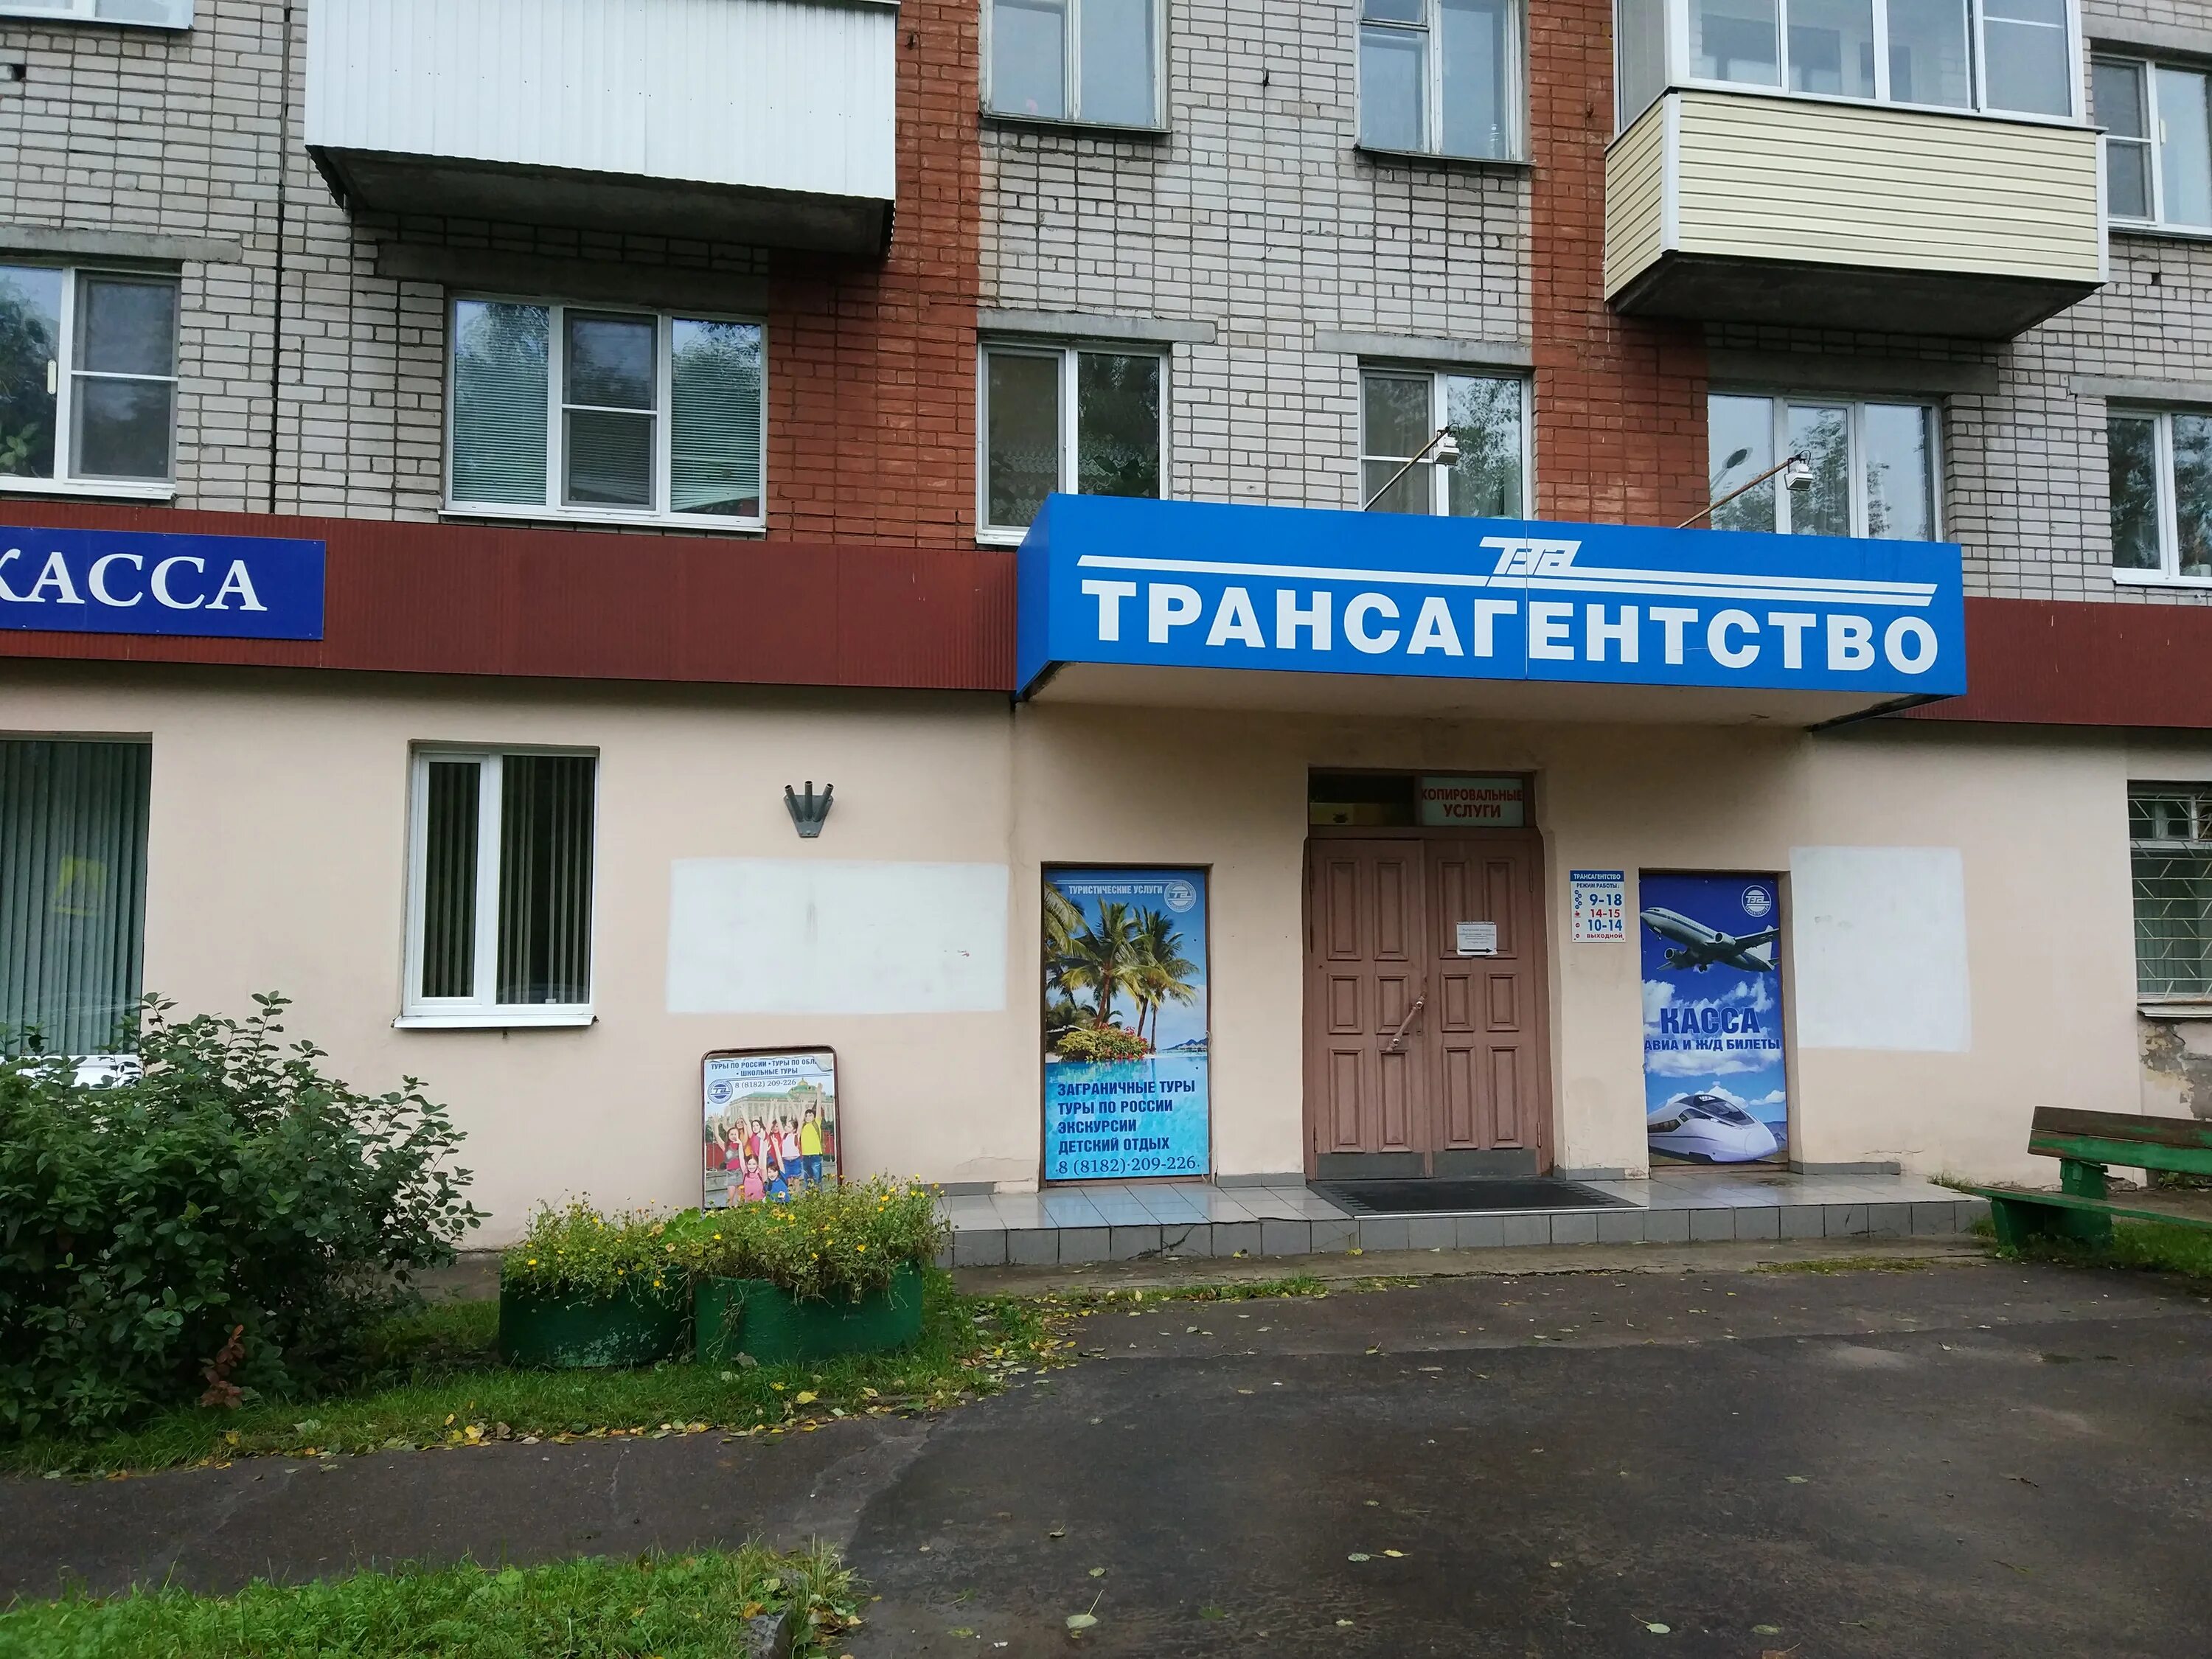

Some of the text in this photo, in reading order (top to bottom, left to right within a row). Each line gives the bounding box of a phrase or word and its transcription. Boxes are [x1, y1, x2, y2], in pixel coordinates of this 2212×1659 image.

[1082, 580, 1938, 675] ТРАНСАГЕНТСТВО
[1422, 788, 1523, 801] КОПИРОВАЛЬНЫЕ
[1443, 804, 1501, 818] УСЛУГИ
[1068, 885, 1163, 894] ТУРИСТИЧЕСКИЕ УСЛУГИ
[1590, 894, 1622, 905] 9-18
[1590, 908, 1621, 918] 14-15
[1587, 919, 1623, 931] 10-14
[1660, 1007, 1761, 1034] КАССА
[1644, 1039, 1781, 1051] АВИА И Ж/Д БИЛЕТЫ
[740, 1068, 779, 1077] ШКОЛЬНЫЕ
[741, 1080, 765, 1088] (8182)
[1057, 1080, 1195, 1096] ЗАГРАНИЧНЫЕ ТУРЫ
[1057, 1099, 1173, 1115] ТУРЫ ПО РОССИИ
[1058, 1119, 1137, 1133] ЭКСКУРСИИ
[1058, 1137, 1170, 1155] ДЕТСКИЙ ОТДЫХ
[1058, 1155, 1196, 1175] 8 (8182) 209-226
